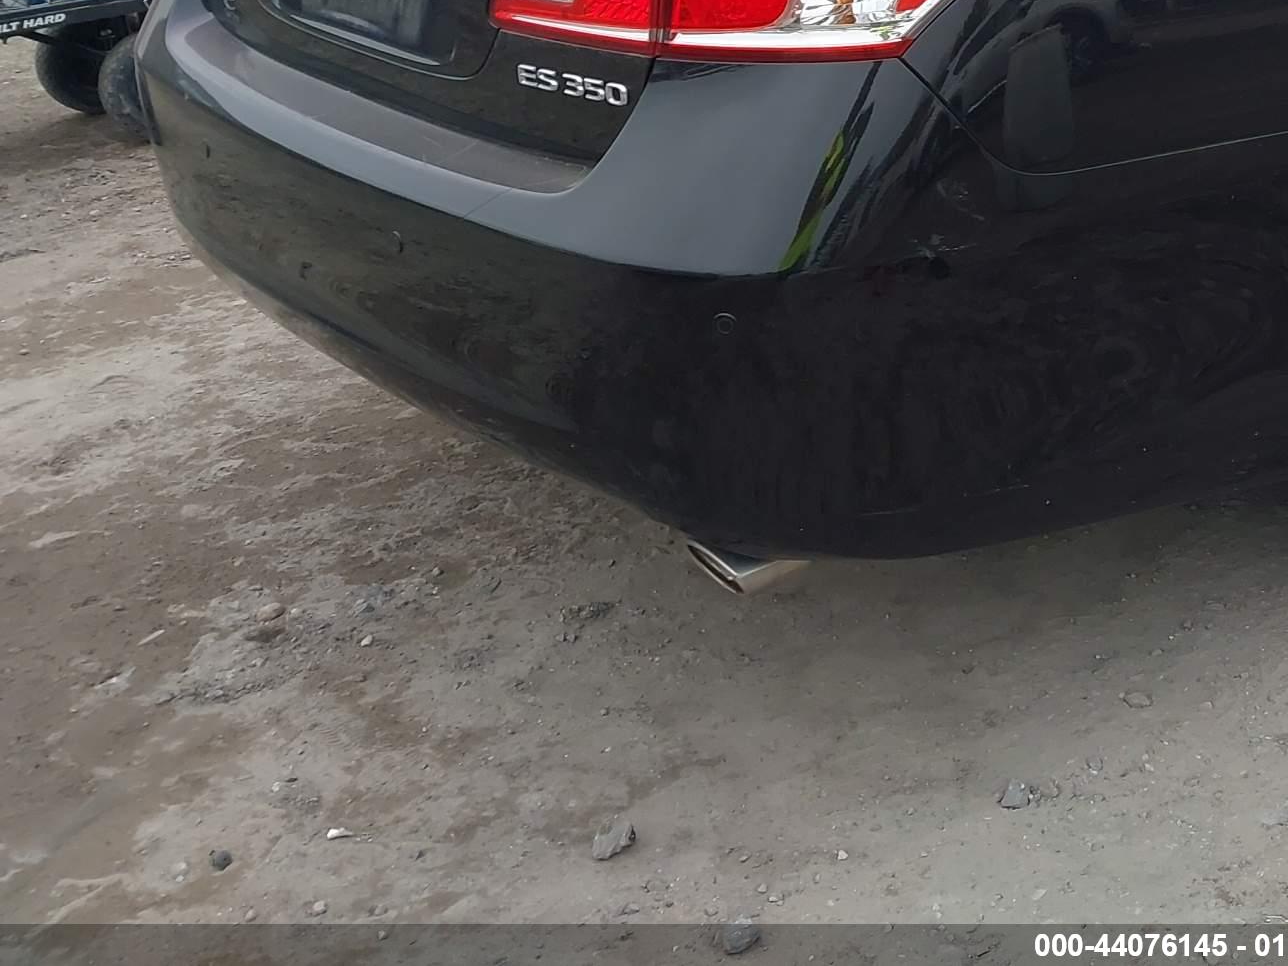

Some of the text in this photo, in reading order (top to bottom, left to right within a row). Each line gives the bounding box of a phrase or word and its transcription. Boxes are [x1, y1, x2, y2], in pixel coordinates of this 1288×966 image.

[22, 13, 67, 29] HARD
[517, 63, 628, 107] ES 350
